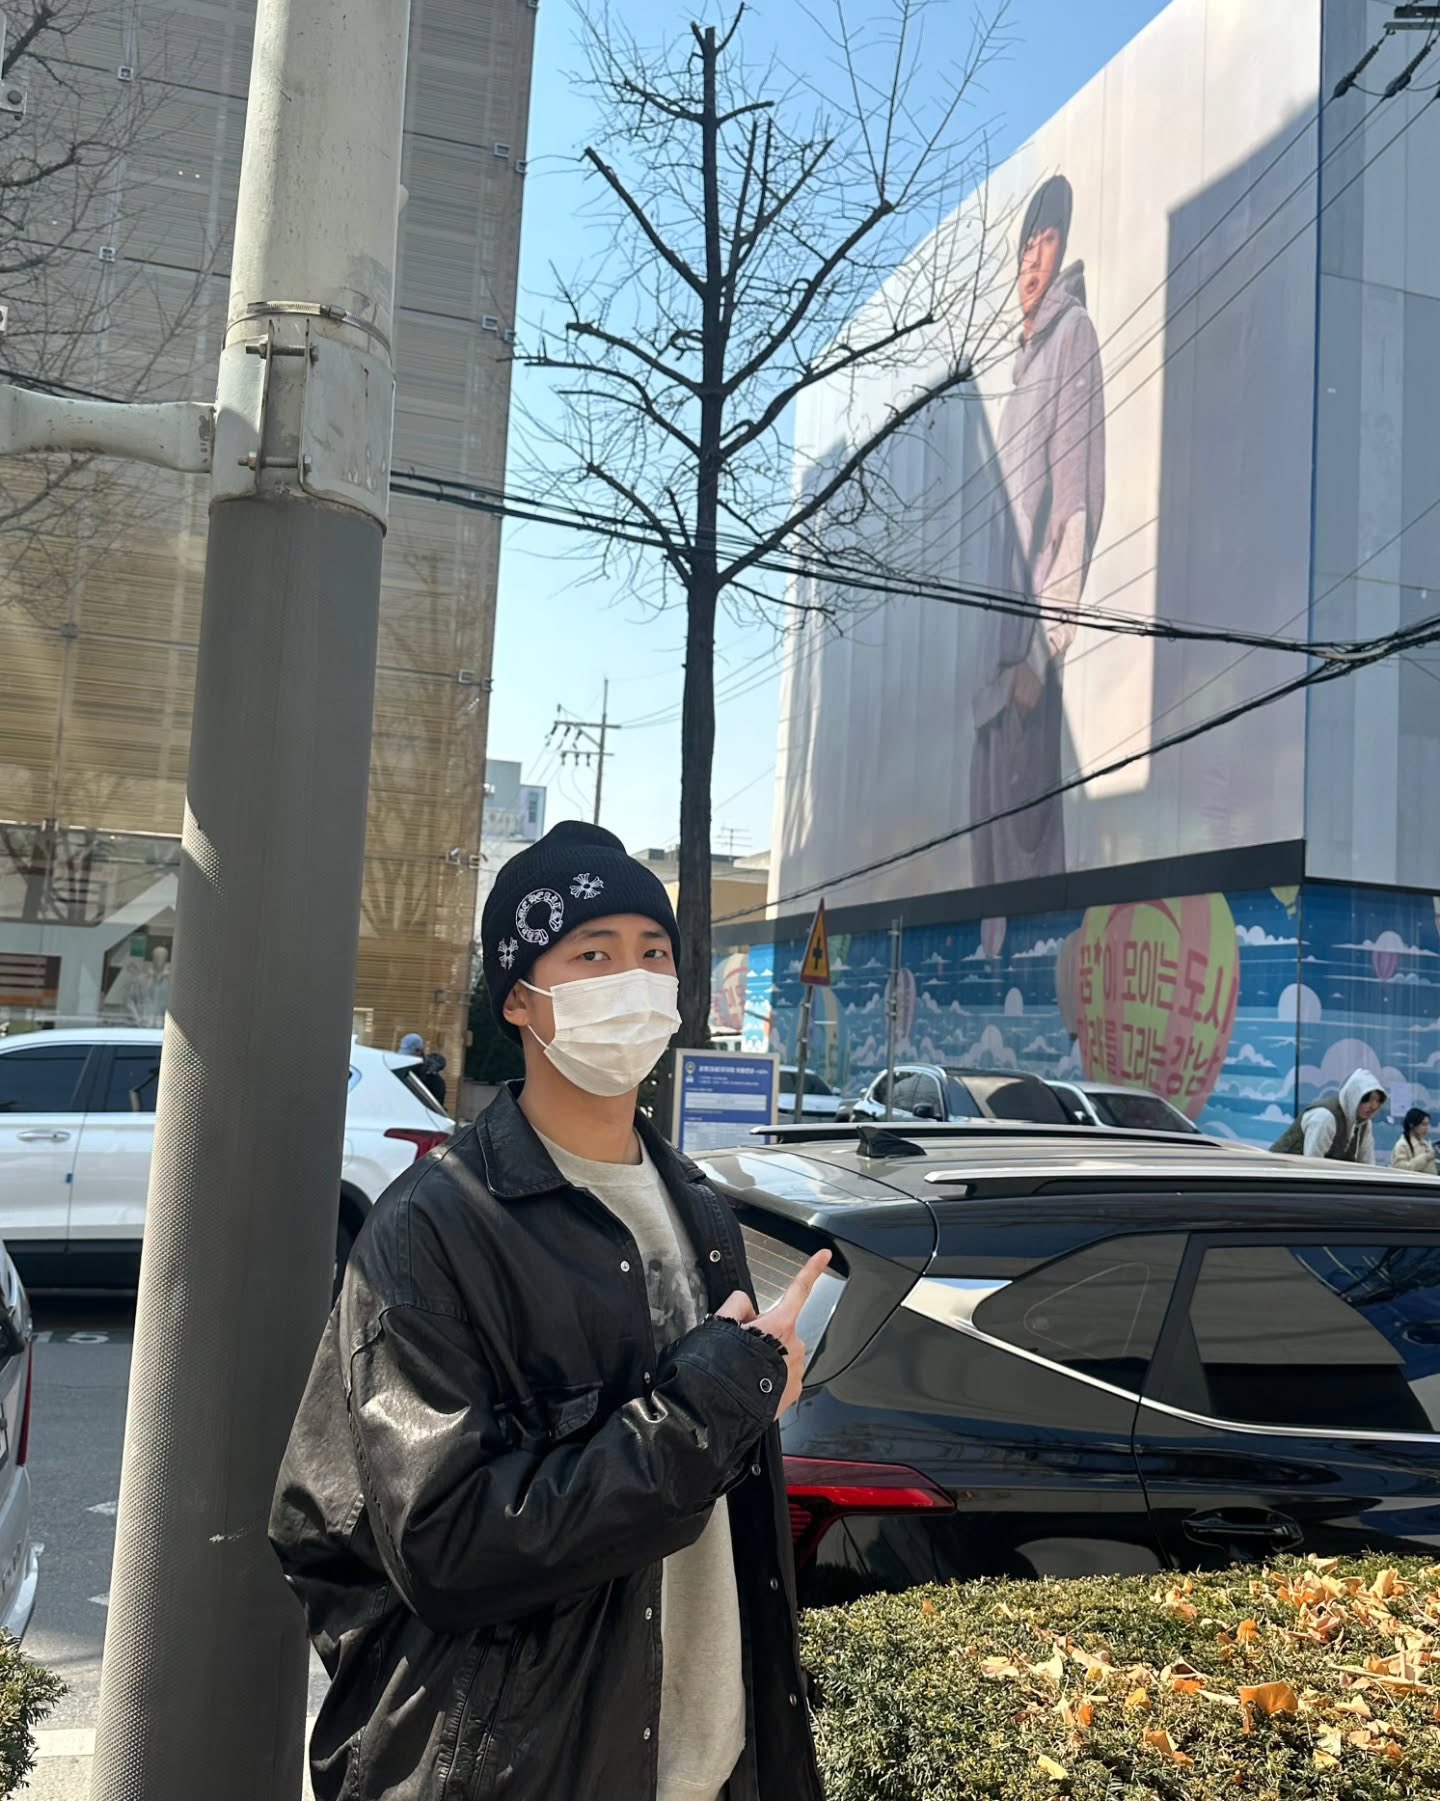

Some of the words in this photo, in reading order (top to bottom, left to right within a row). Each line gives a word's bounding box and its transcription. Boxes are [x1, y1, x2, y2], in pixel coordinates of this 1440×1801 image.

[1121, 940, 1178, 1011] 모이는
[1179, 948, 1238, 1034] 도시
[1119, 1022, 1167, 1091] 그리는
[1166, 1036, 1220, 1095] 강남
